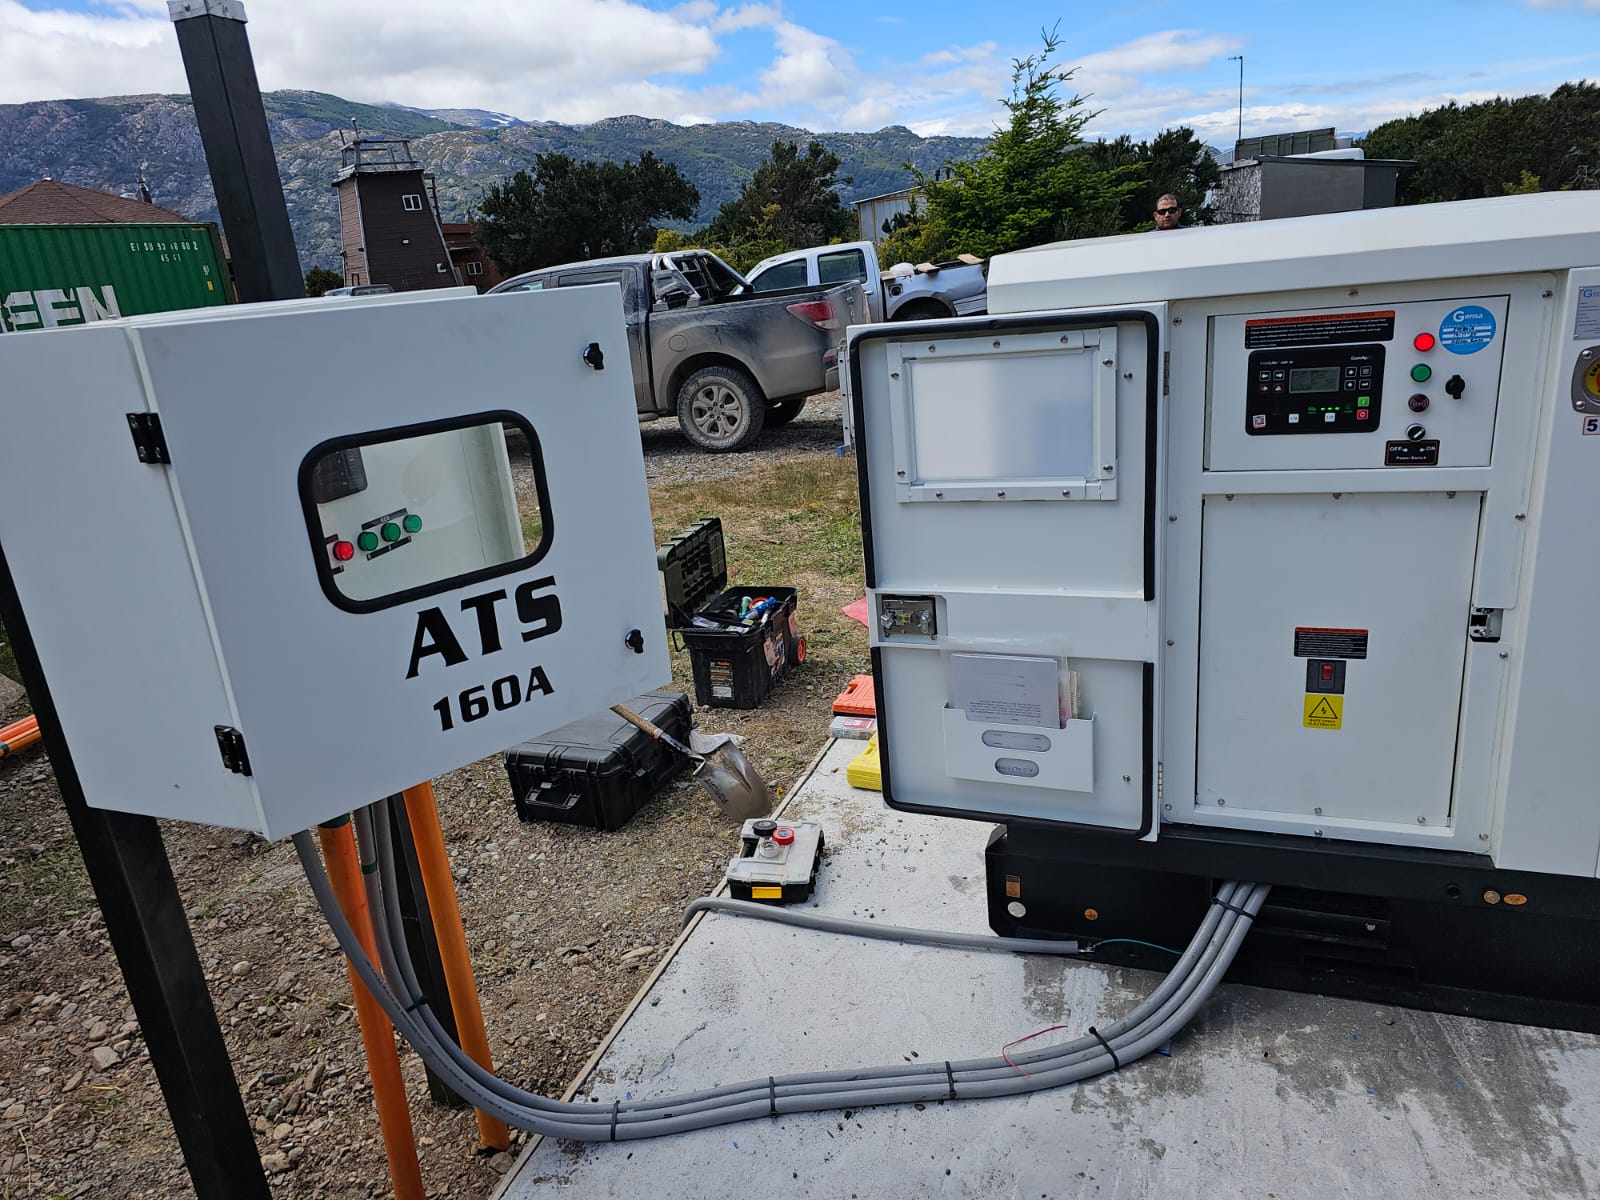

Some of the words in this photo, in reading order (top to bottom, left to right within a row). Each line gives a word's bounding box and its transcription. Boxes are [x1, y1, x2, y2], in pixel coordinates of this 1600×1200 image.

[1586, 418, 1600, 432] 5
[405, 575, 563, 680] ATS
[433, 665, 554, 732] 160A
